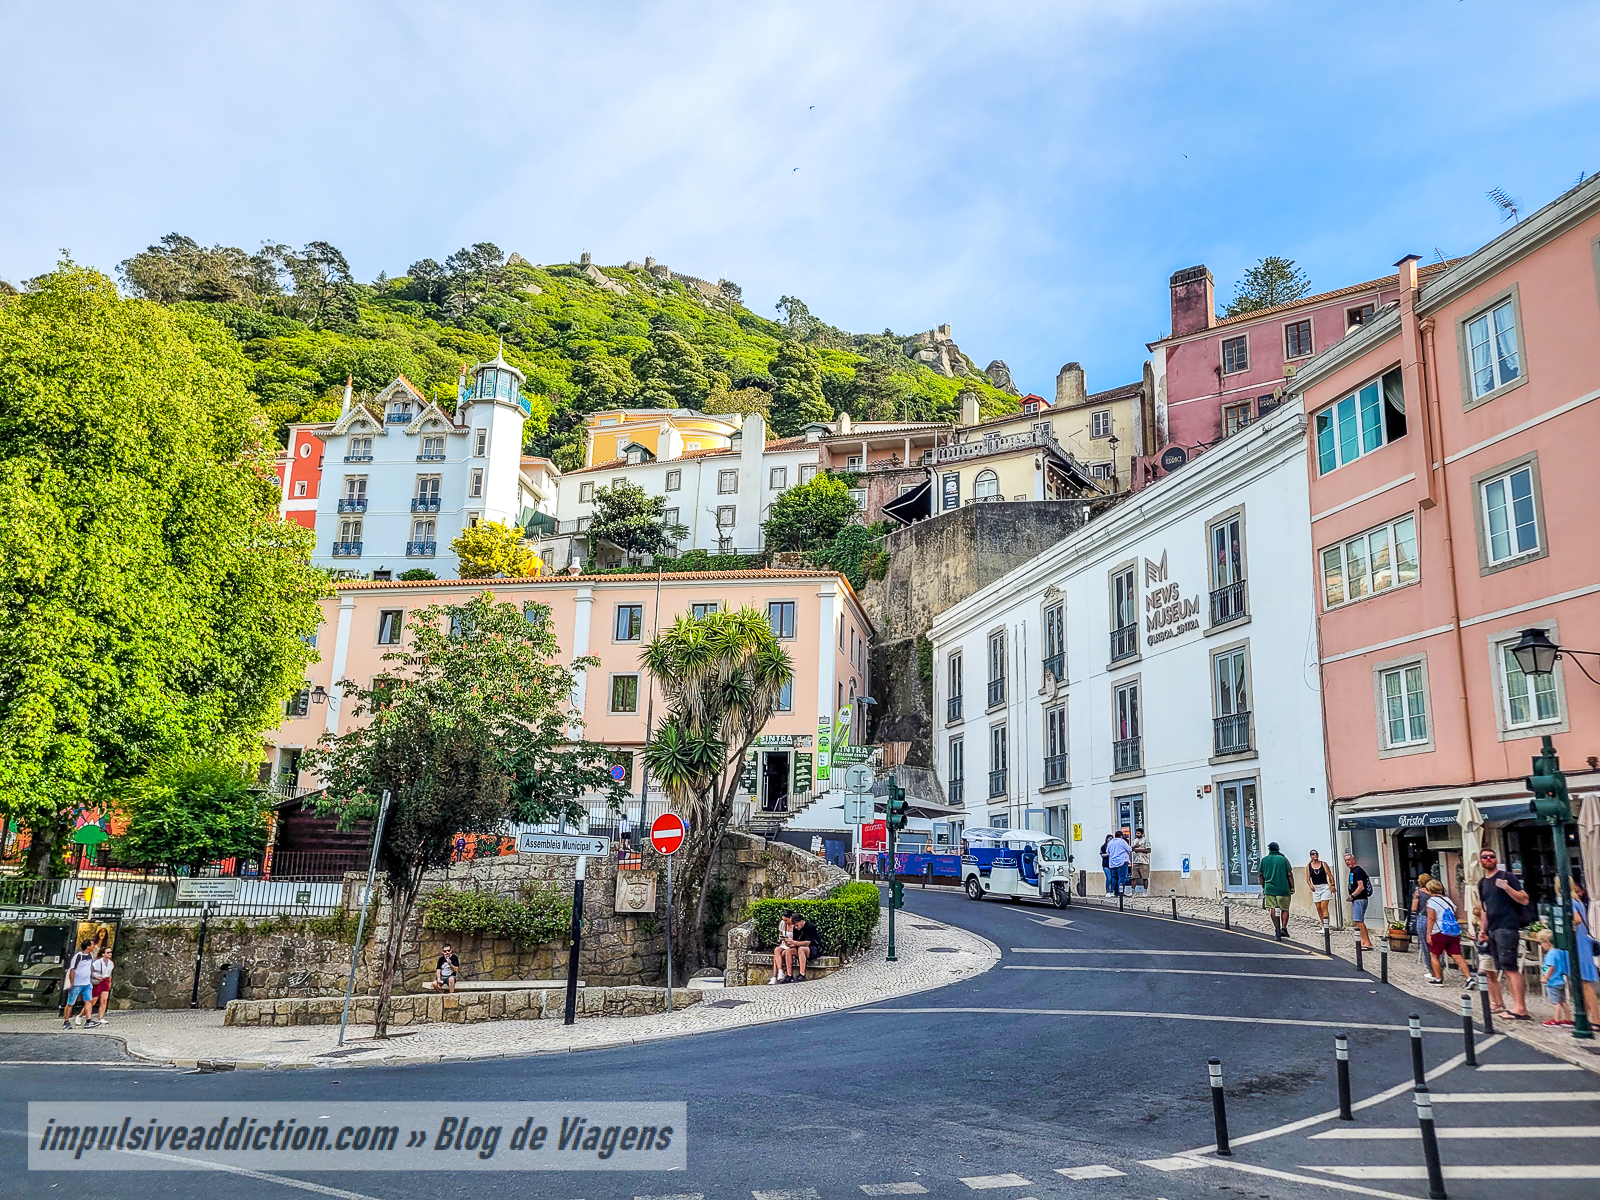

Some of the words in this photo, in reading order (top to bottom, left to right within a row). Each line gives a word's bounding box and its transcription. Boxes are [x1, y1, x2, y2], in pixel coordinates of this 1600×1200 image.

[1145, 582, 1180, 613] NEWS
[1146, 594, 1200, 633] MUSEUM
[402, 656, 425, 666] SINT
[1398, 813, 1428, 827] Bristol
[525, 838, 560, 850] Assembleia
[562, 839, 591, 853] Municipal
[882, 852, 910, 863] TPAS
